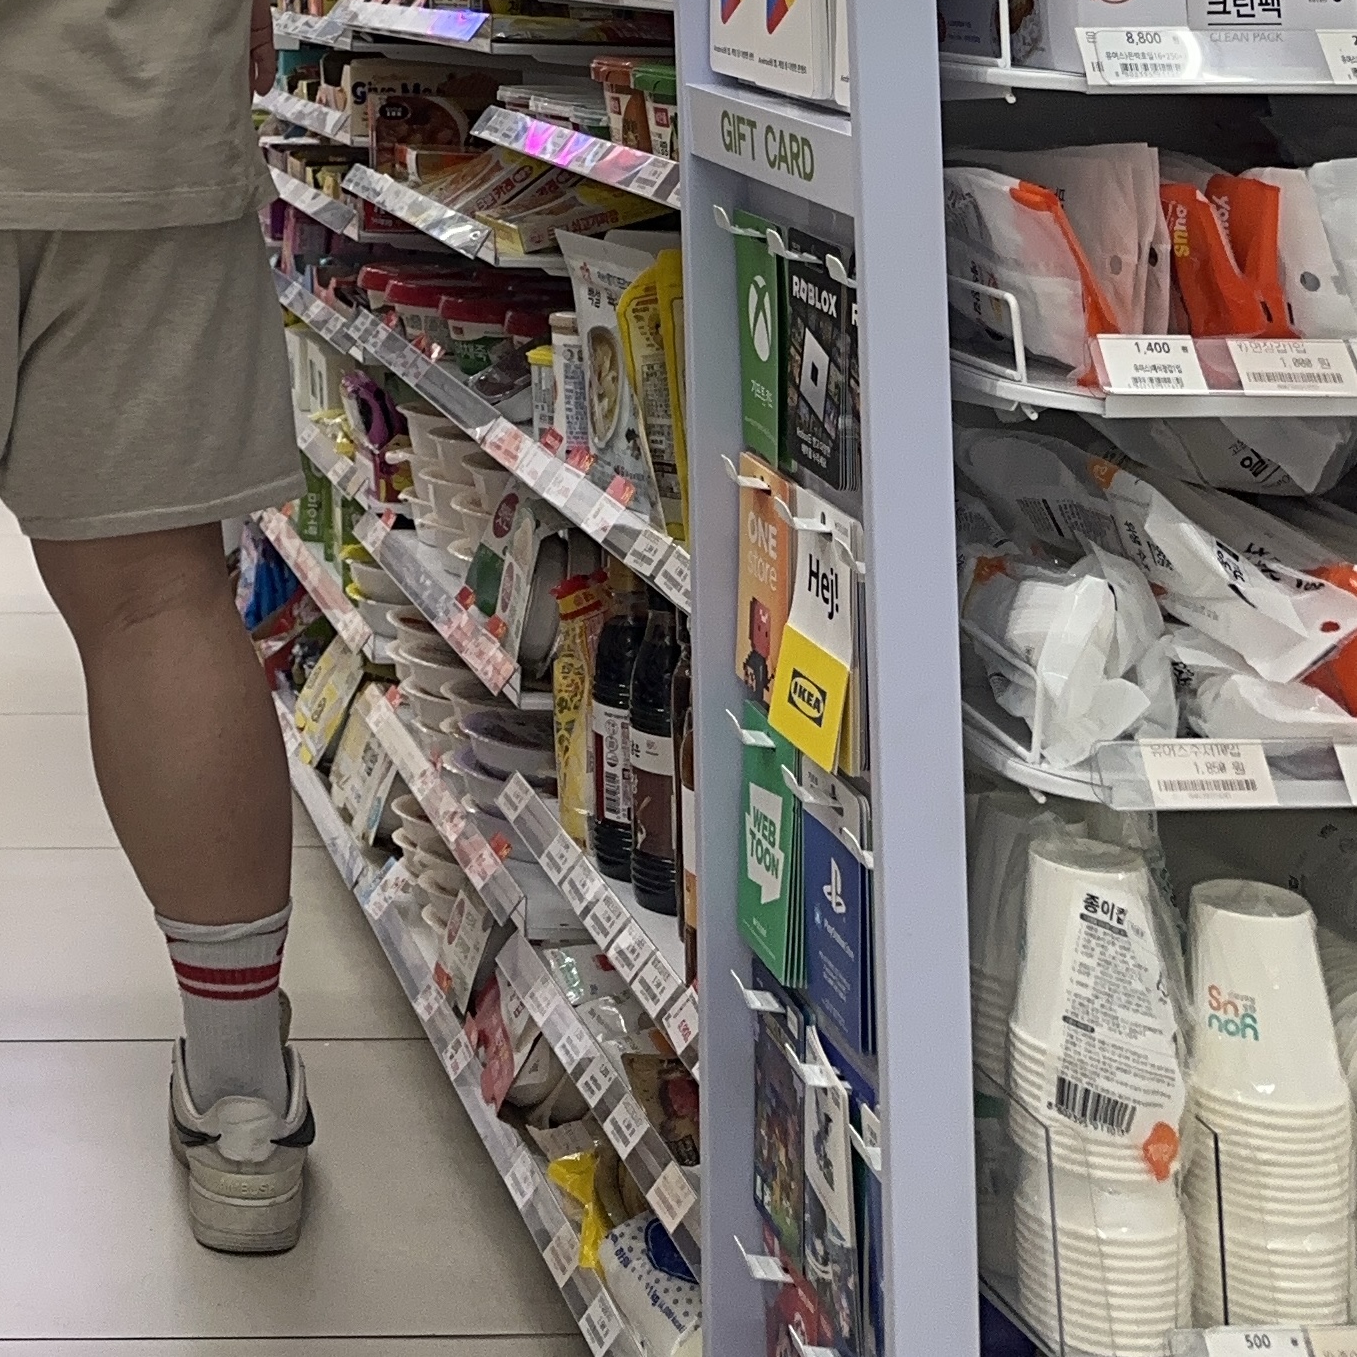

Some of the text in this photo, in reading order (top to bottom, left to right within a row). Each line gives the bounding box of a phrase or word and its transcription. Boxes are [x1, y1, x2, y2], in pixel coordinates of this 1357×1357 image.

[1125, 30, 1162, 44] 8,800
[1209, 31, 1284, 43] CLEAN PACK
[720, 110, 815, 183] GIFT CARD
[791, 274, 838, 319] ROBLOX
[1134, 341, 1171, 355] 1,400
[746, 510, 778, 561] ONE
[746, 551, 778, 593] store
[808, 553, 840, 621] Hej!
[792, 677, 823, 715] IKEA
[752, 805, 776, 843] WEB
[749, 838, 780, 881] TOON
[1082, 892, 1128, 928] 종이컵
[1244, 1333, 1271, 1349] 500
